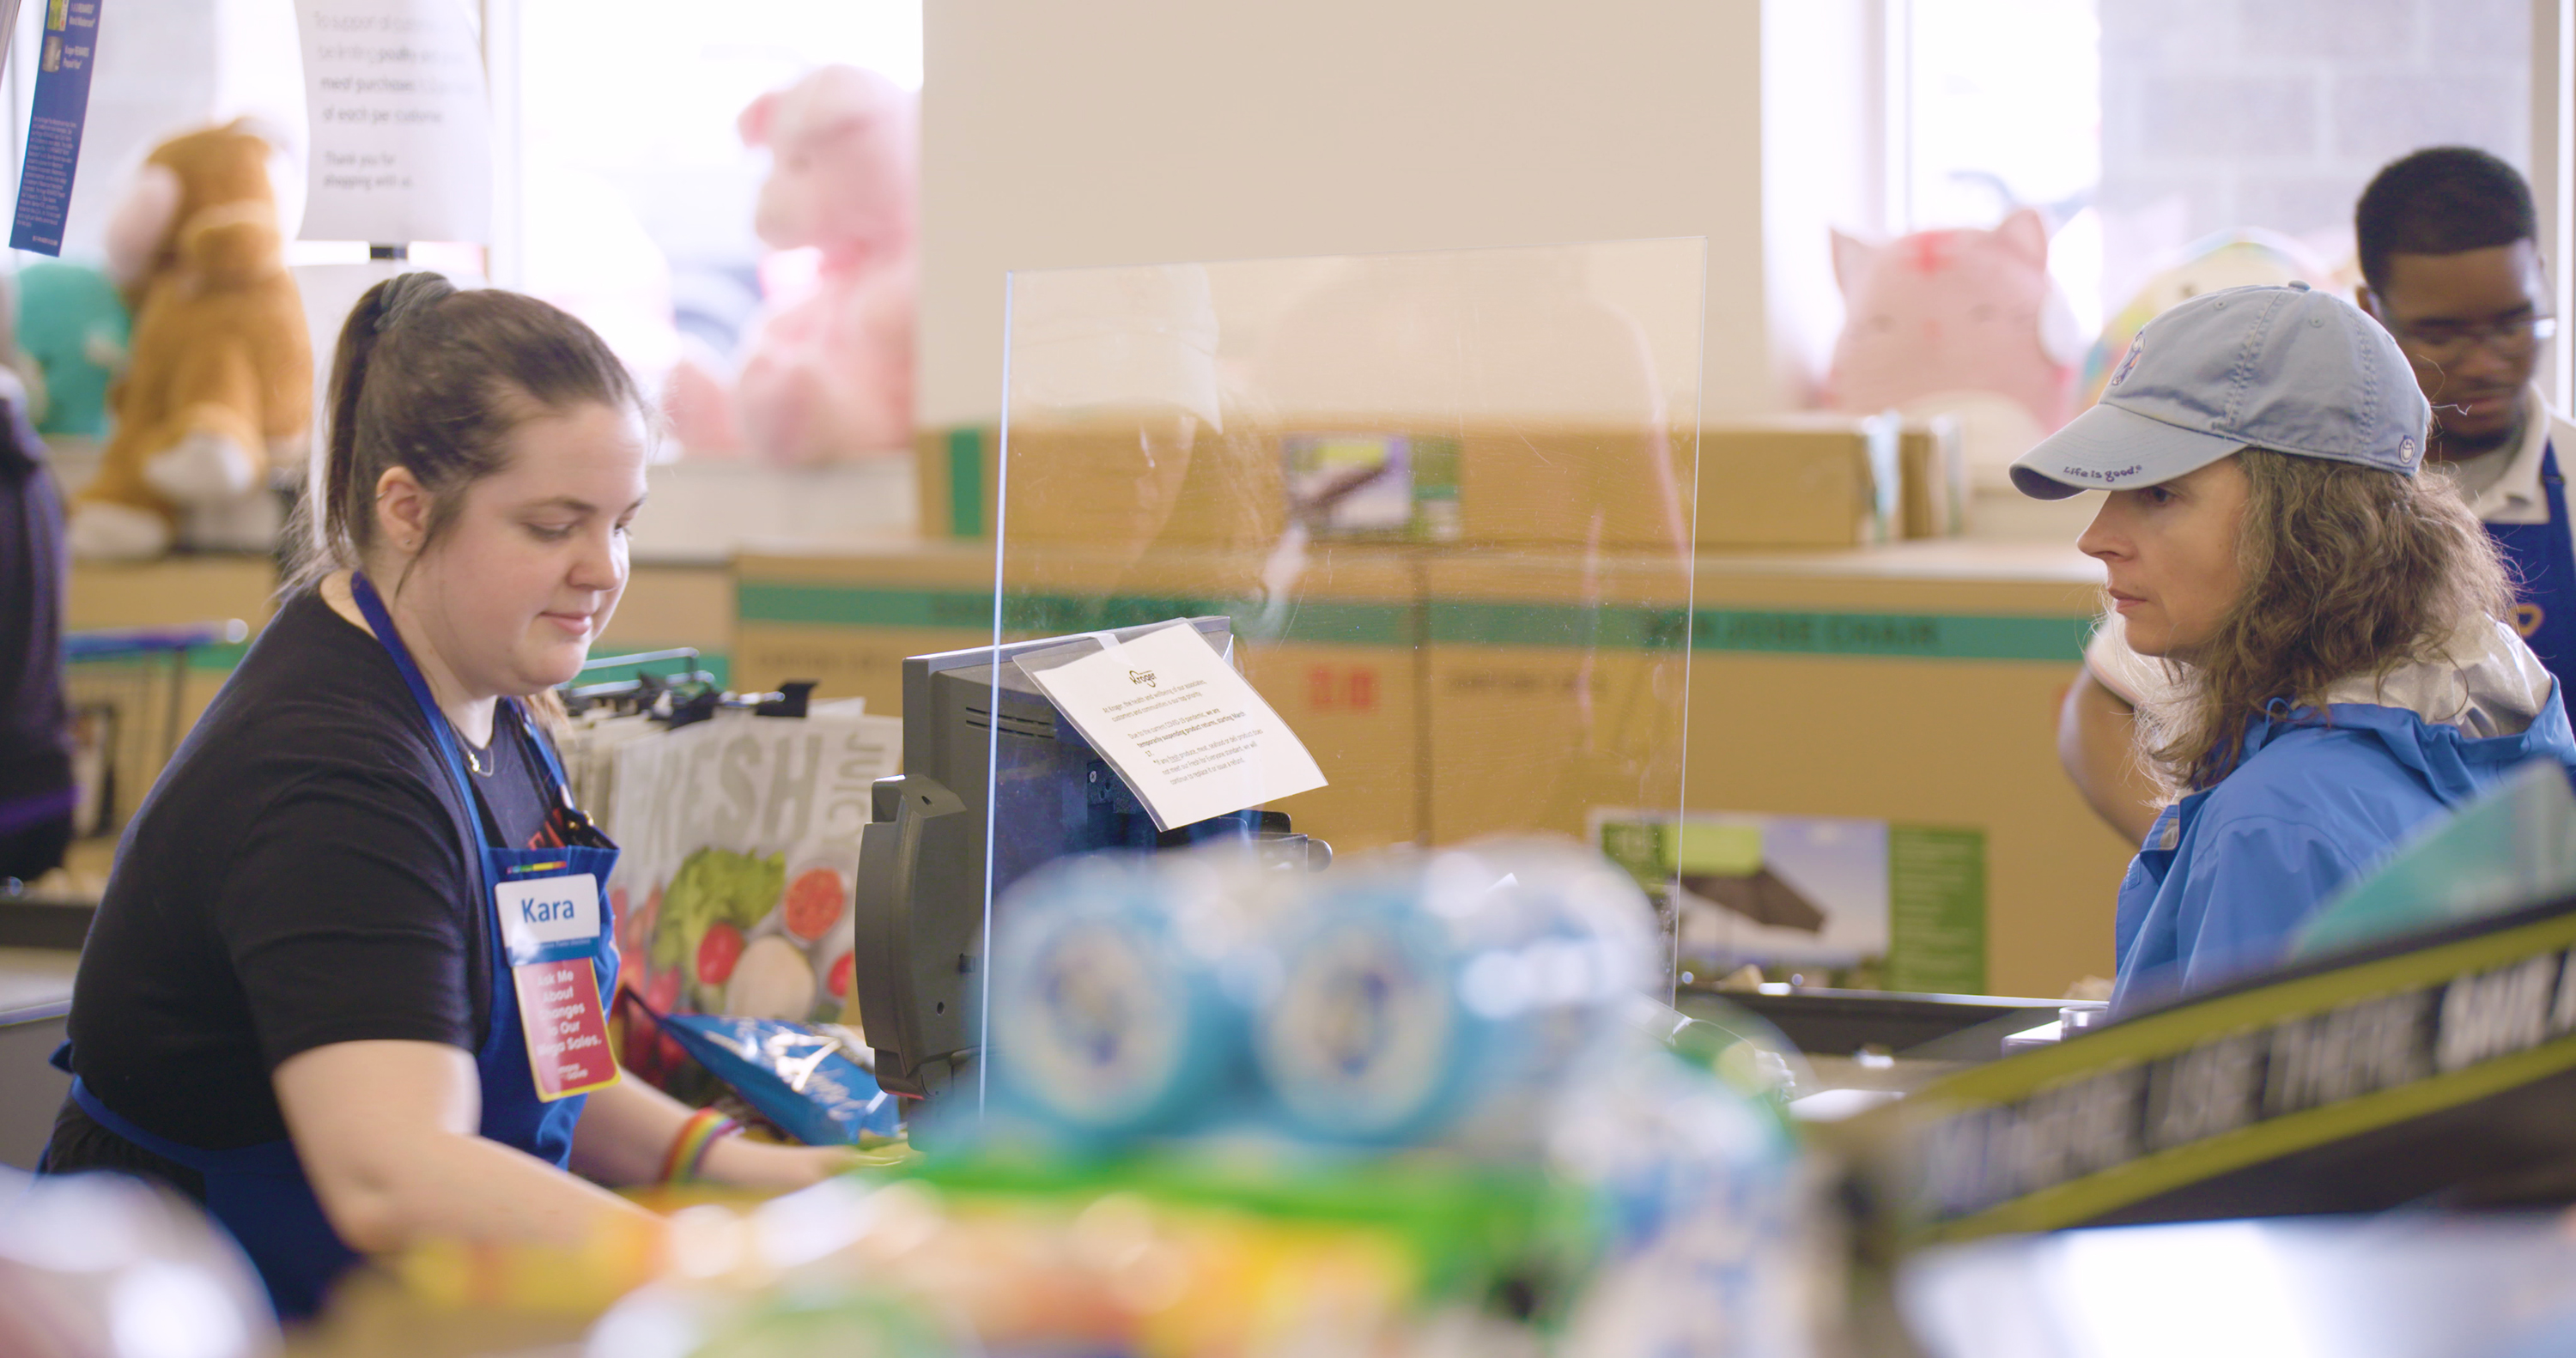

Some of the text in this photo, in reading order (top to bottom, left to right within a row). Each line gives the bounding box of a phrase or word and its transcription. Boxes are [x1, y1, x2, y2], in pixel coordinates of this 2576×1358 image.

[2063, 466, 2088, 477] Life
[2091, 470, 2103, 479] is
[1129, 670, 1157, 688] Kroger
[1111, 712, 1134, 722] customers
[1141, 701, 1168, 712] communities
[1136, 736, 1163, 748] temporarily
[1161, 729, 1187, 740] suspending
[1184, 724, 1201, 734] product
[1150, 724, 1164, 732] current
[1178, 749, 1198, 758] produce,
[1208, 739, 1225, 749] seafood
[1236, 731, 1254, 740] product
[1205, 752, 1225, 761] Everyone
[1170, 775, 1188, 785] continue
[1192, 768, 1208, 777] replace
[521, 898, 574, 923] Kara
[556, 969, 574, 984] Me
[543, 985, 574, 1002] About
[560, 1021, 580, 1034] Our
[567, 1034, 602, 1051] Sales.
